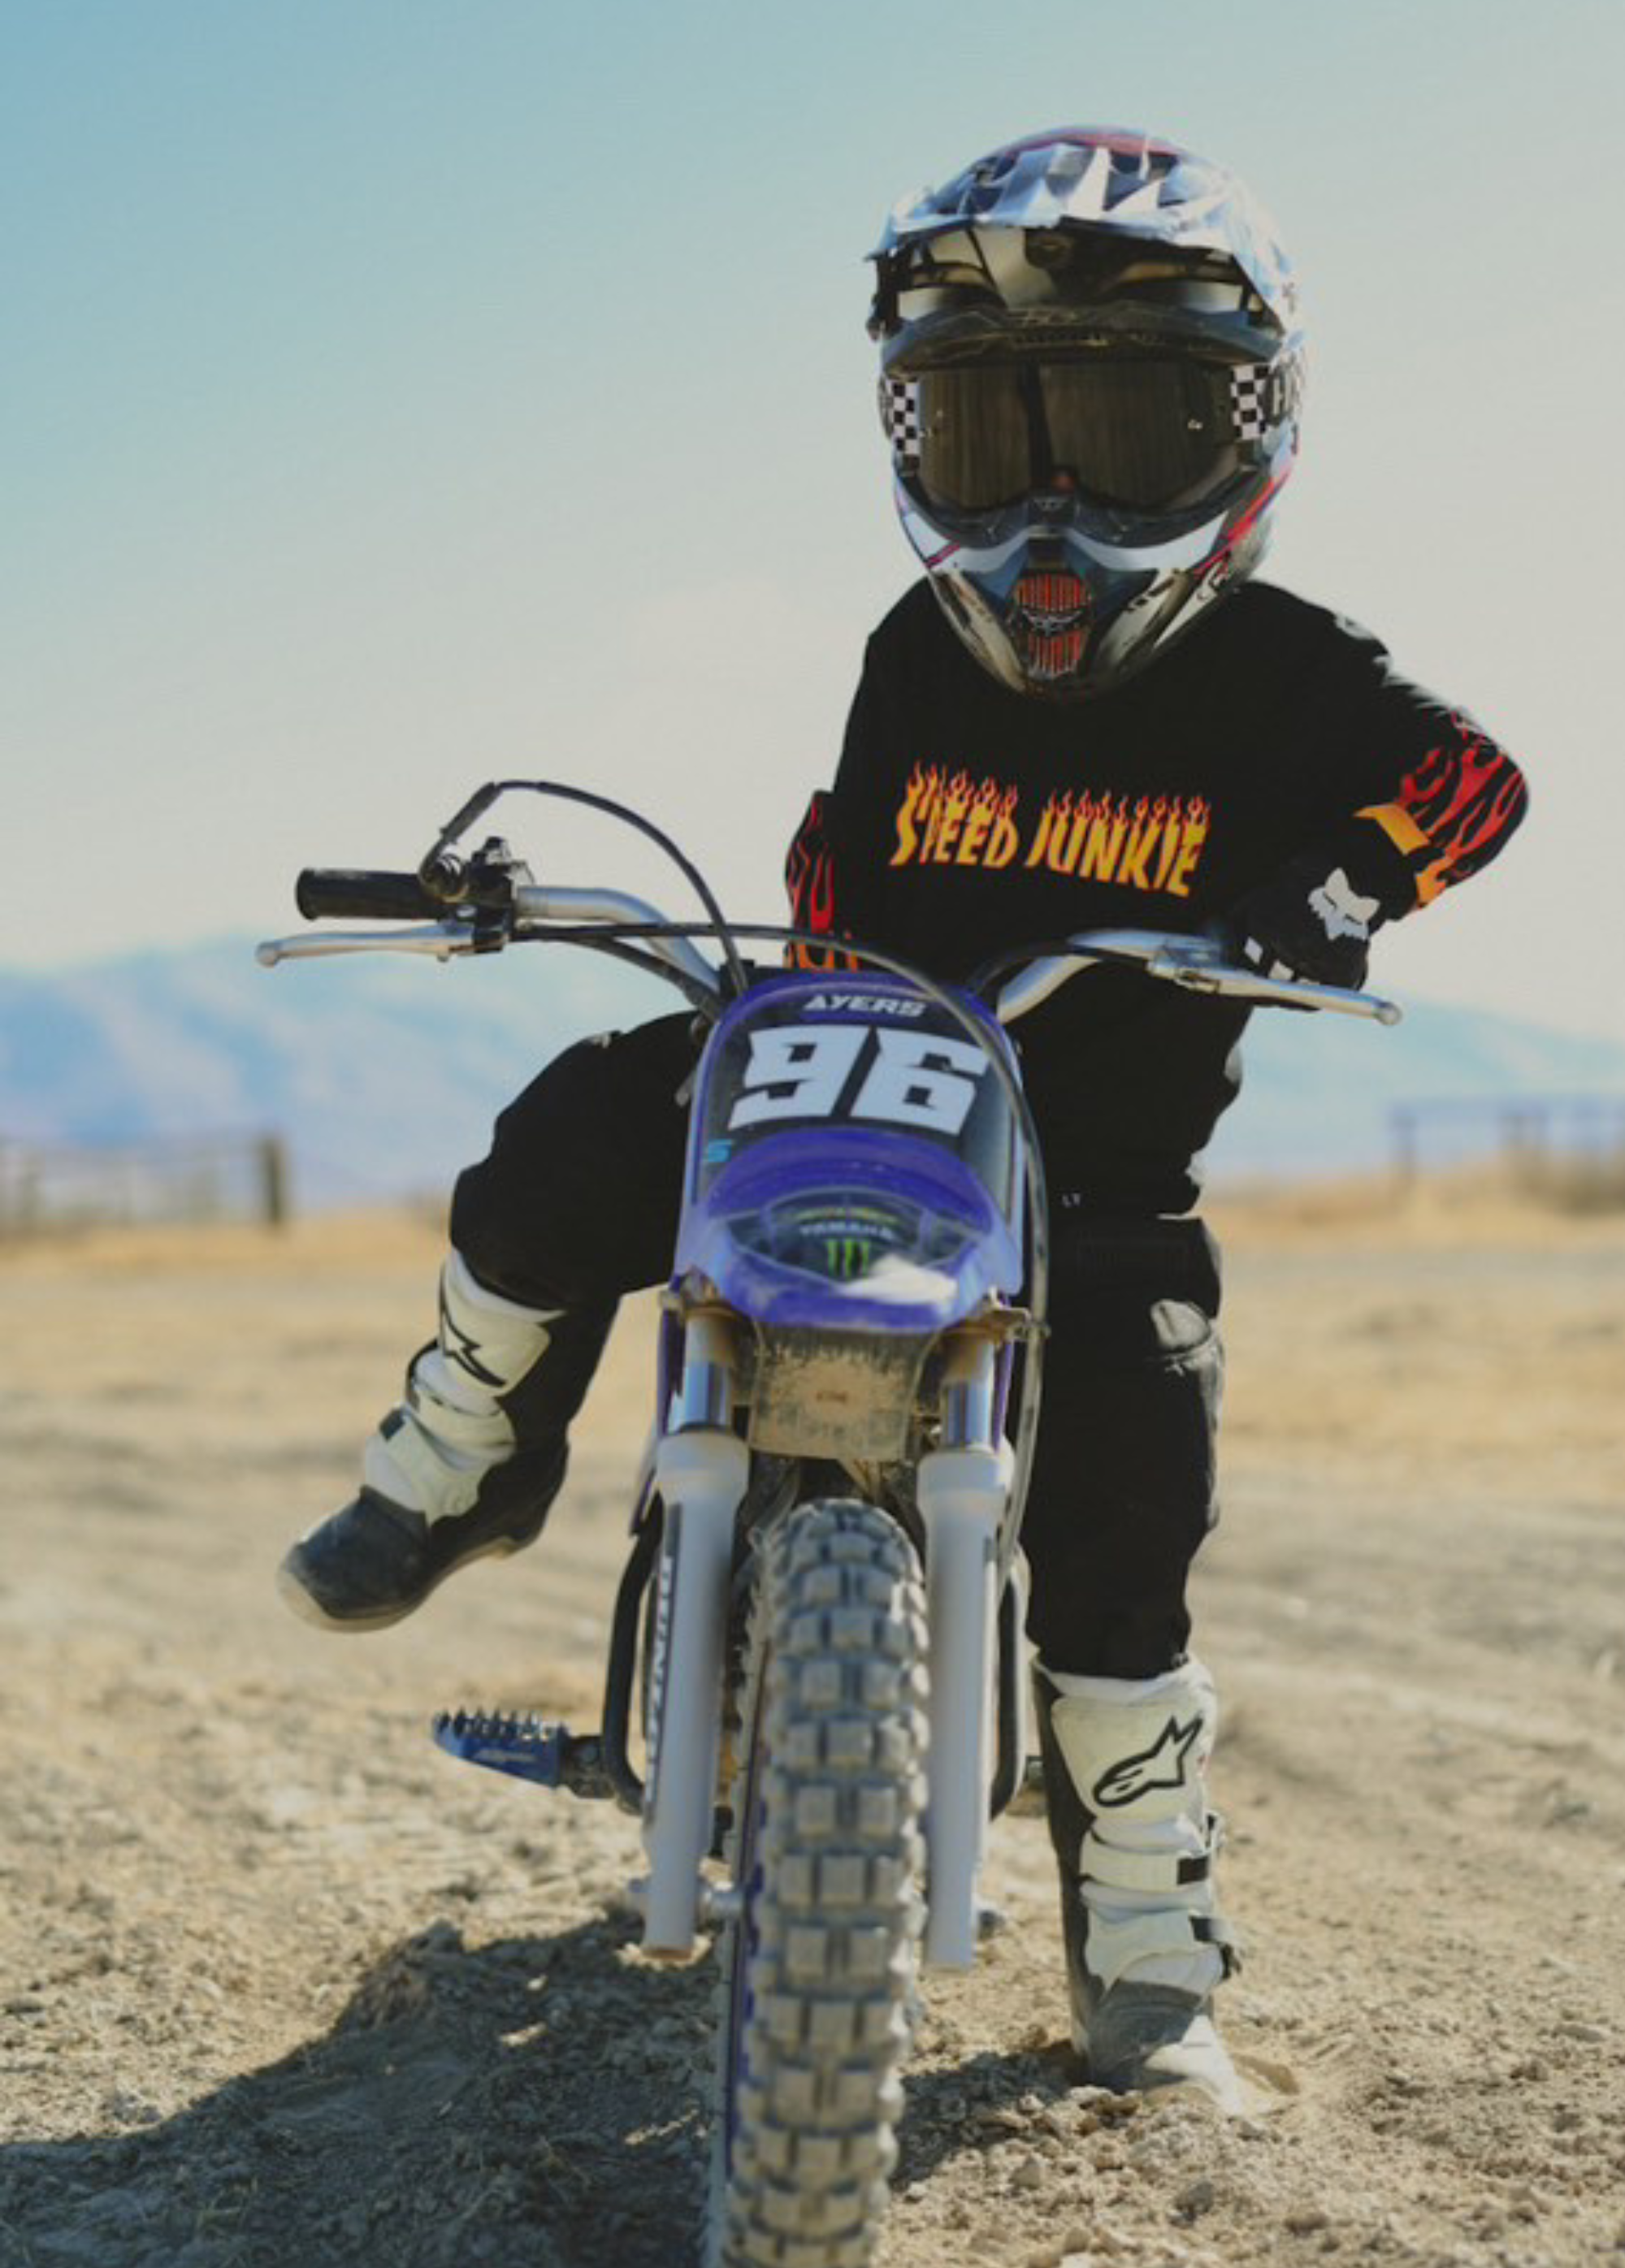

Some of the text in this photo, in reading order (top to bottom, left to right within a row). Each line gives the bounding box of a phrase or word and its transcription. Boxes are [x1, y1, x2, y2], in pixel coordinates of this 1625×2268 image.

[890, 760, 1211, 897] SPEED JUNKIE
[803, 994, 927, 1018] AYERS
[729, 1025, 990, 1135] 96
